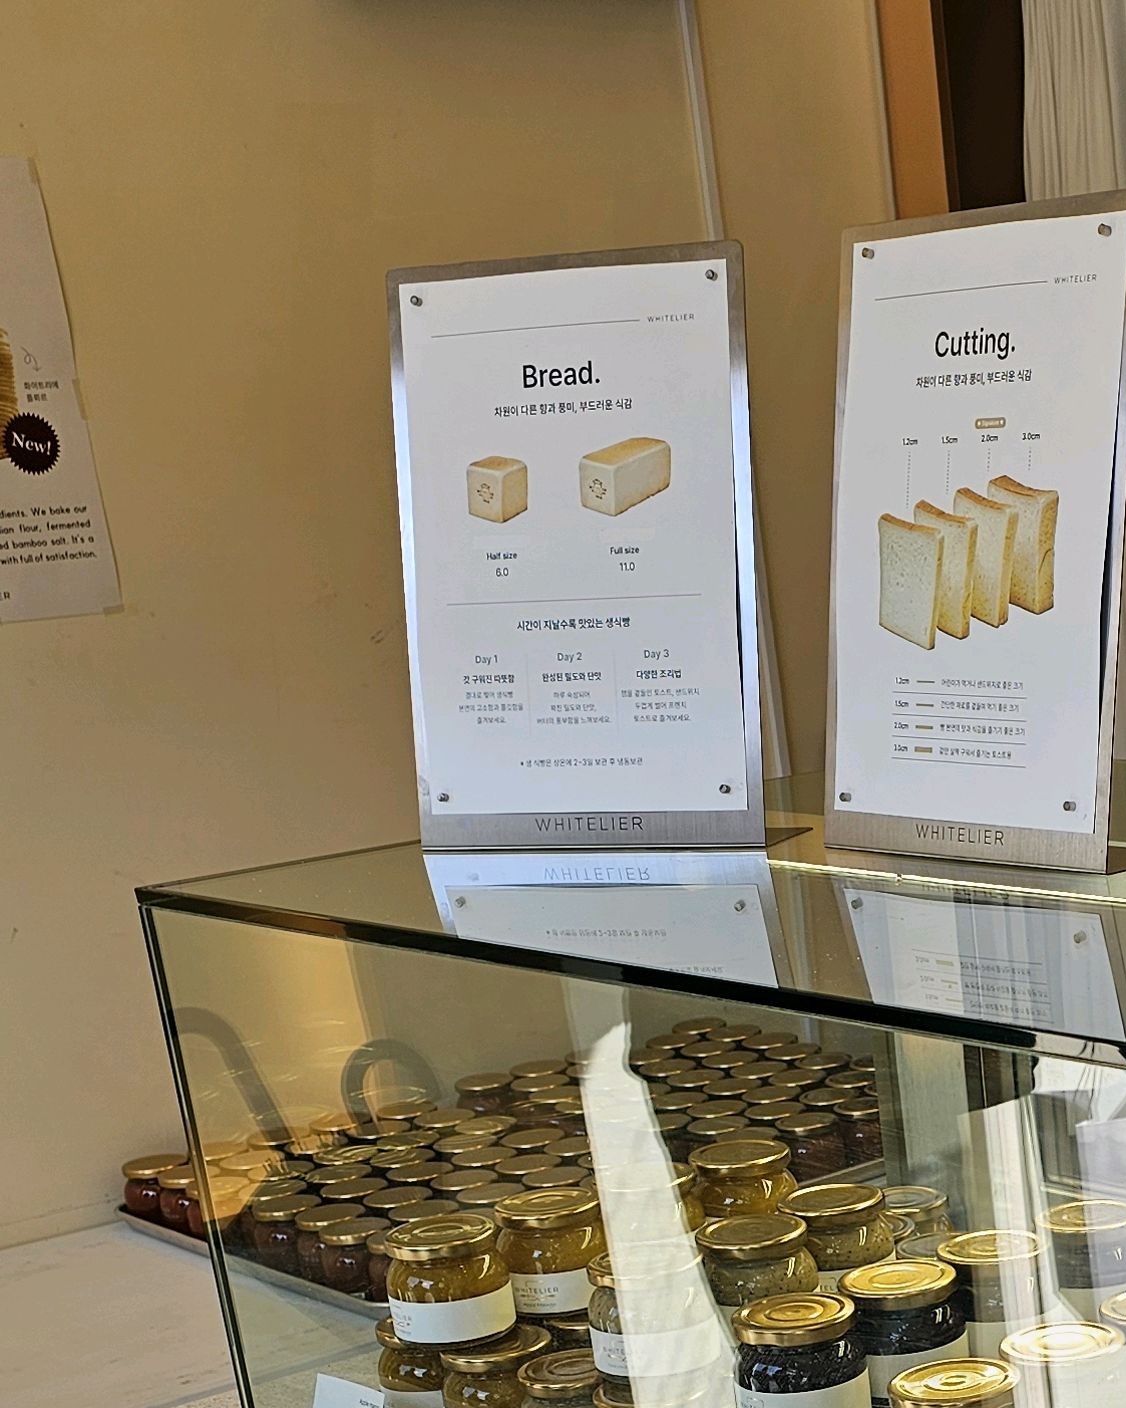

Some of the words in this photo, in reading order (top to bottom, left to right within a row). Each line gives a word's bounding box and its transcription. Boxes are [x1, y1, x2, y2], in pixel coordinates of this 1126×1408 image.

[1053, 274, 1097, 284] WHITELIER
[647, 313, 695, 323] WHITELIER
[935, 327, 1016, 360] Cutting.
[522, 361, 600, 388] Bread.
[915, 375, 937, 388] 차원이
[938, 374, 952, 387] 다른
[987, 370, 1015, 385] 부드러운
[1017, 369, 1032, 382] 식감
[494, 405, 519, 417] 차원이
[520, 404, 537, 416] 다른
[539, 402, 556, 415] 향과
[558, 401, 577, 414] 풍미,
[579, 399, 613, 413] 부드러운
[615, 398, 632, 411] 식감
[902, 438, 918, 446] 1.2cm
[941, 436, 958, 445] 1.5cm
[981, 434, 998, 443] 2.0cm
[1022, 432, 1041, 441] 3.0cm
[12, 431, 51, 456] New!
[31, 507, 46, 516] We
[49, 506, 70, 515] bake
[74, 505, 87, 513] our
[47, 519, 91, 531] fermented
[12, 538, 47, 549] bamboo
[71, 534, 85, 544] It's
[610, 546, 623, 555] Full
[625, 545, 639, 554] size
[1, 555, 19, 565] with
[35, 552, 43, 563] of
[46, 550, 97, 562] satisfaction.
[486, 551, 502, 561] Half
[504, 551, 517, 560] size
[496, 567, 509, 577] 6.0
[619, 562, 635, 572] 11.0
[516, 619, 541, 631] 시간이
[543, 618, 576, 630] 지날수록
[578, 617, 603, 629] 맛있는
[605, 616, 631, 629] 생식빵
[475, 654, 490, 665] Day
[557, 652, 574, 663] Day
[576, 652, 582, 661] 2
[644, 649, 661, 660] Day
[663, 649, 669, 658] 3
[472, 674, 492, 684] 구워진
[542, 671, 563, 683] 완성된
[565, 671, 586, 682] 밀도와
[588, 671, 602, 681] 단맛
[636, 669, 658, 679] 다양한
[659, 668, 681, 679] 조리법
[535, 816, 644, 832] WHITELIER
[916, 823, 1005, 846] WHITELIER
